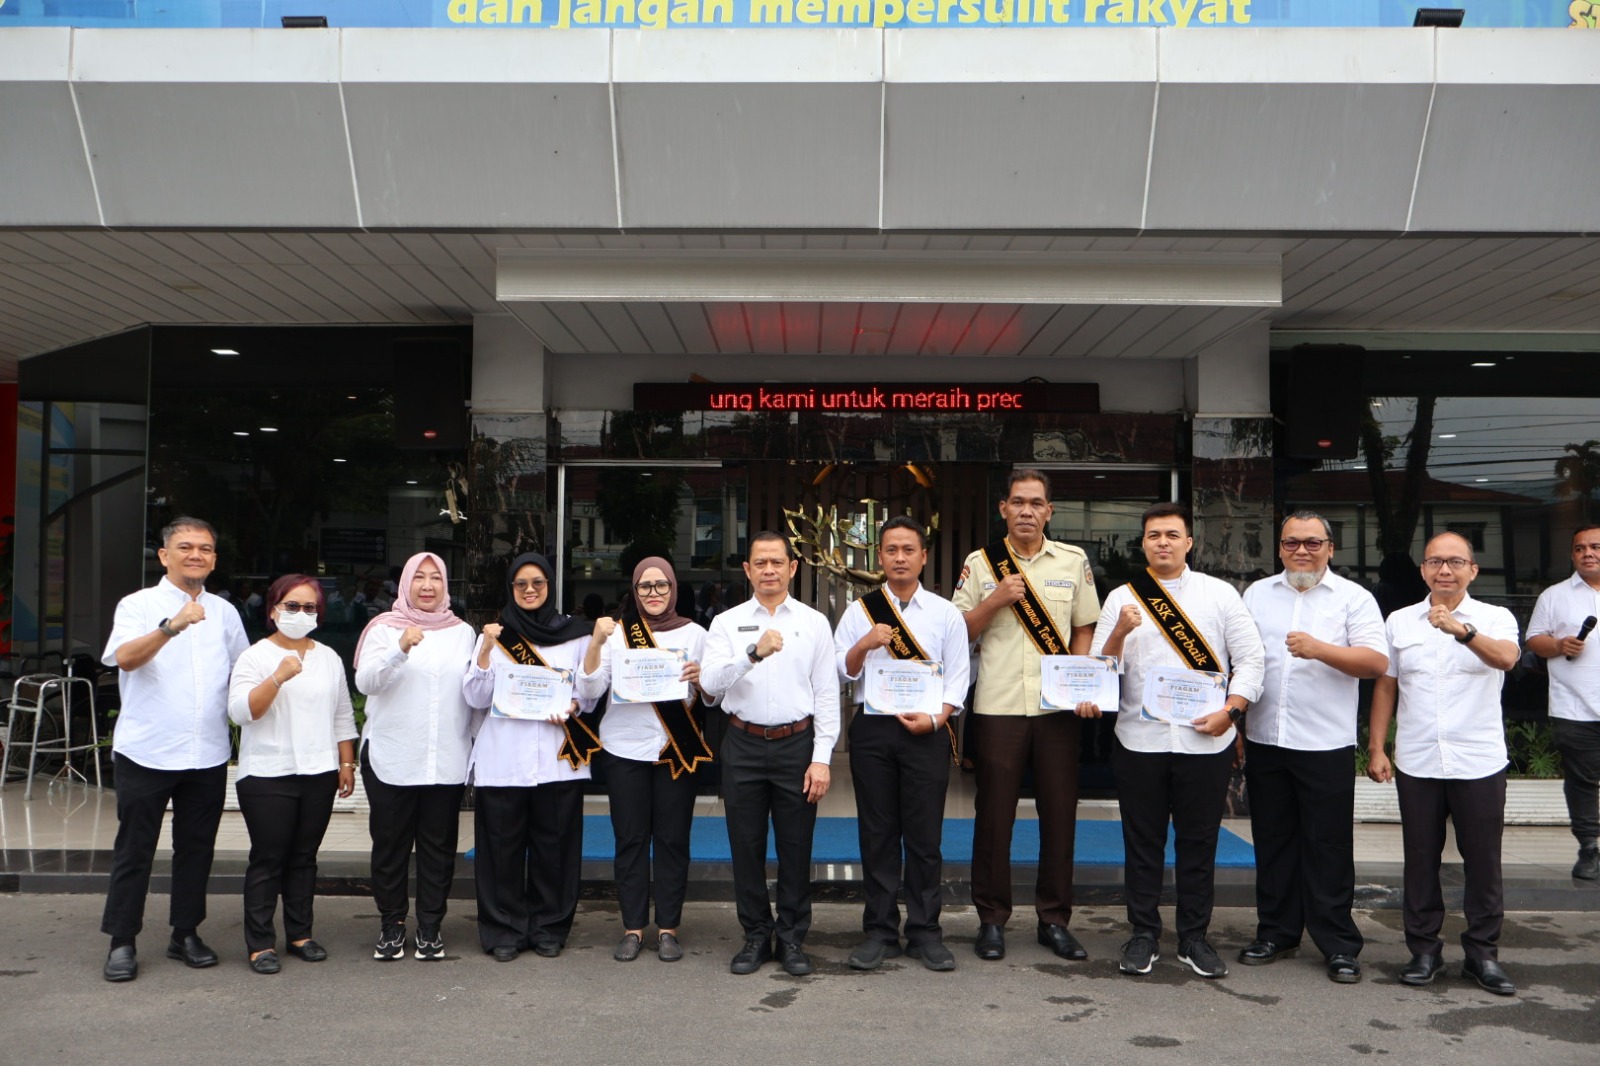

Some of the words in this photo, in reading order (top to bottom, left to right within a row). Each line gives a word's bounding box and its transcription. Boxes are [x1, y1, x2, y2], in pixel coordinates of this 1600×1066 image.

[447, 0, 541, 23] dan
[549, 0, 734, 30] jangan
[749, 0, 1069, 29] mempersulit
[1085, 0, 1251, 29] rakyat
[759, 388, 814, 408] kami
[822, 388, 886, 408] untuk
[892, 388, 970, 408] meraih
[630, 622, 649, 649] PPP
[891, 626, 911, 656] Petugas
[1147, 597, 1176, 621] ASK
[1169, 621, 1208, 666] Terbaik
[1169, 684, 1200, 692] PIAGAM
